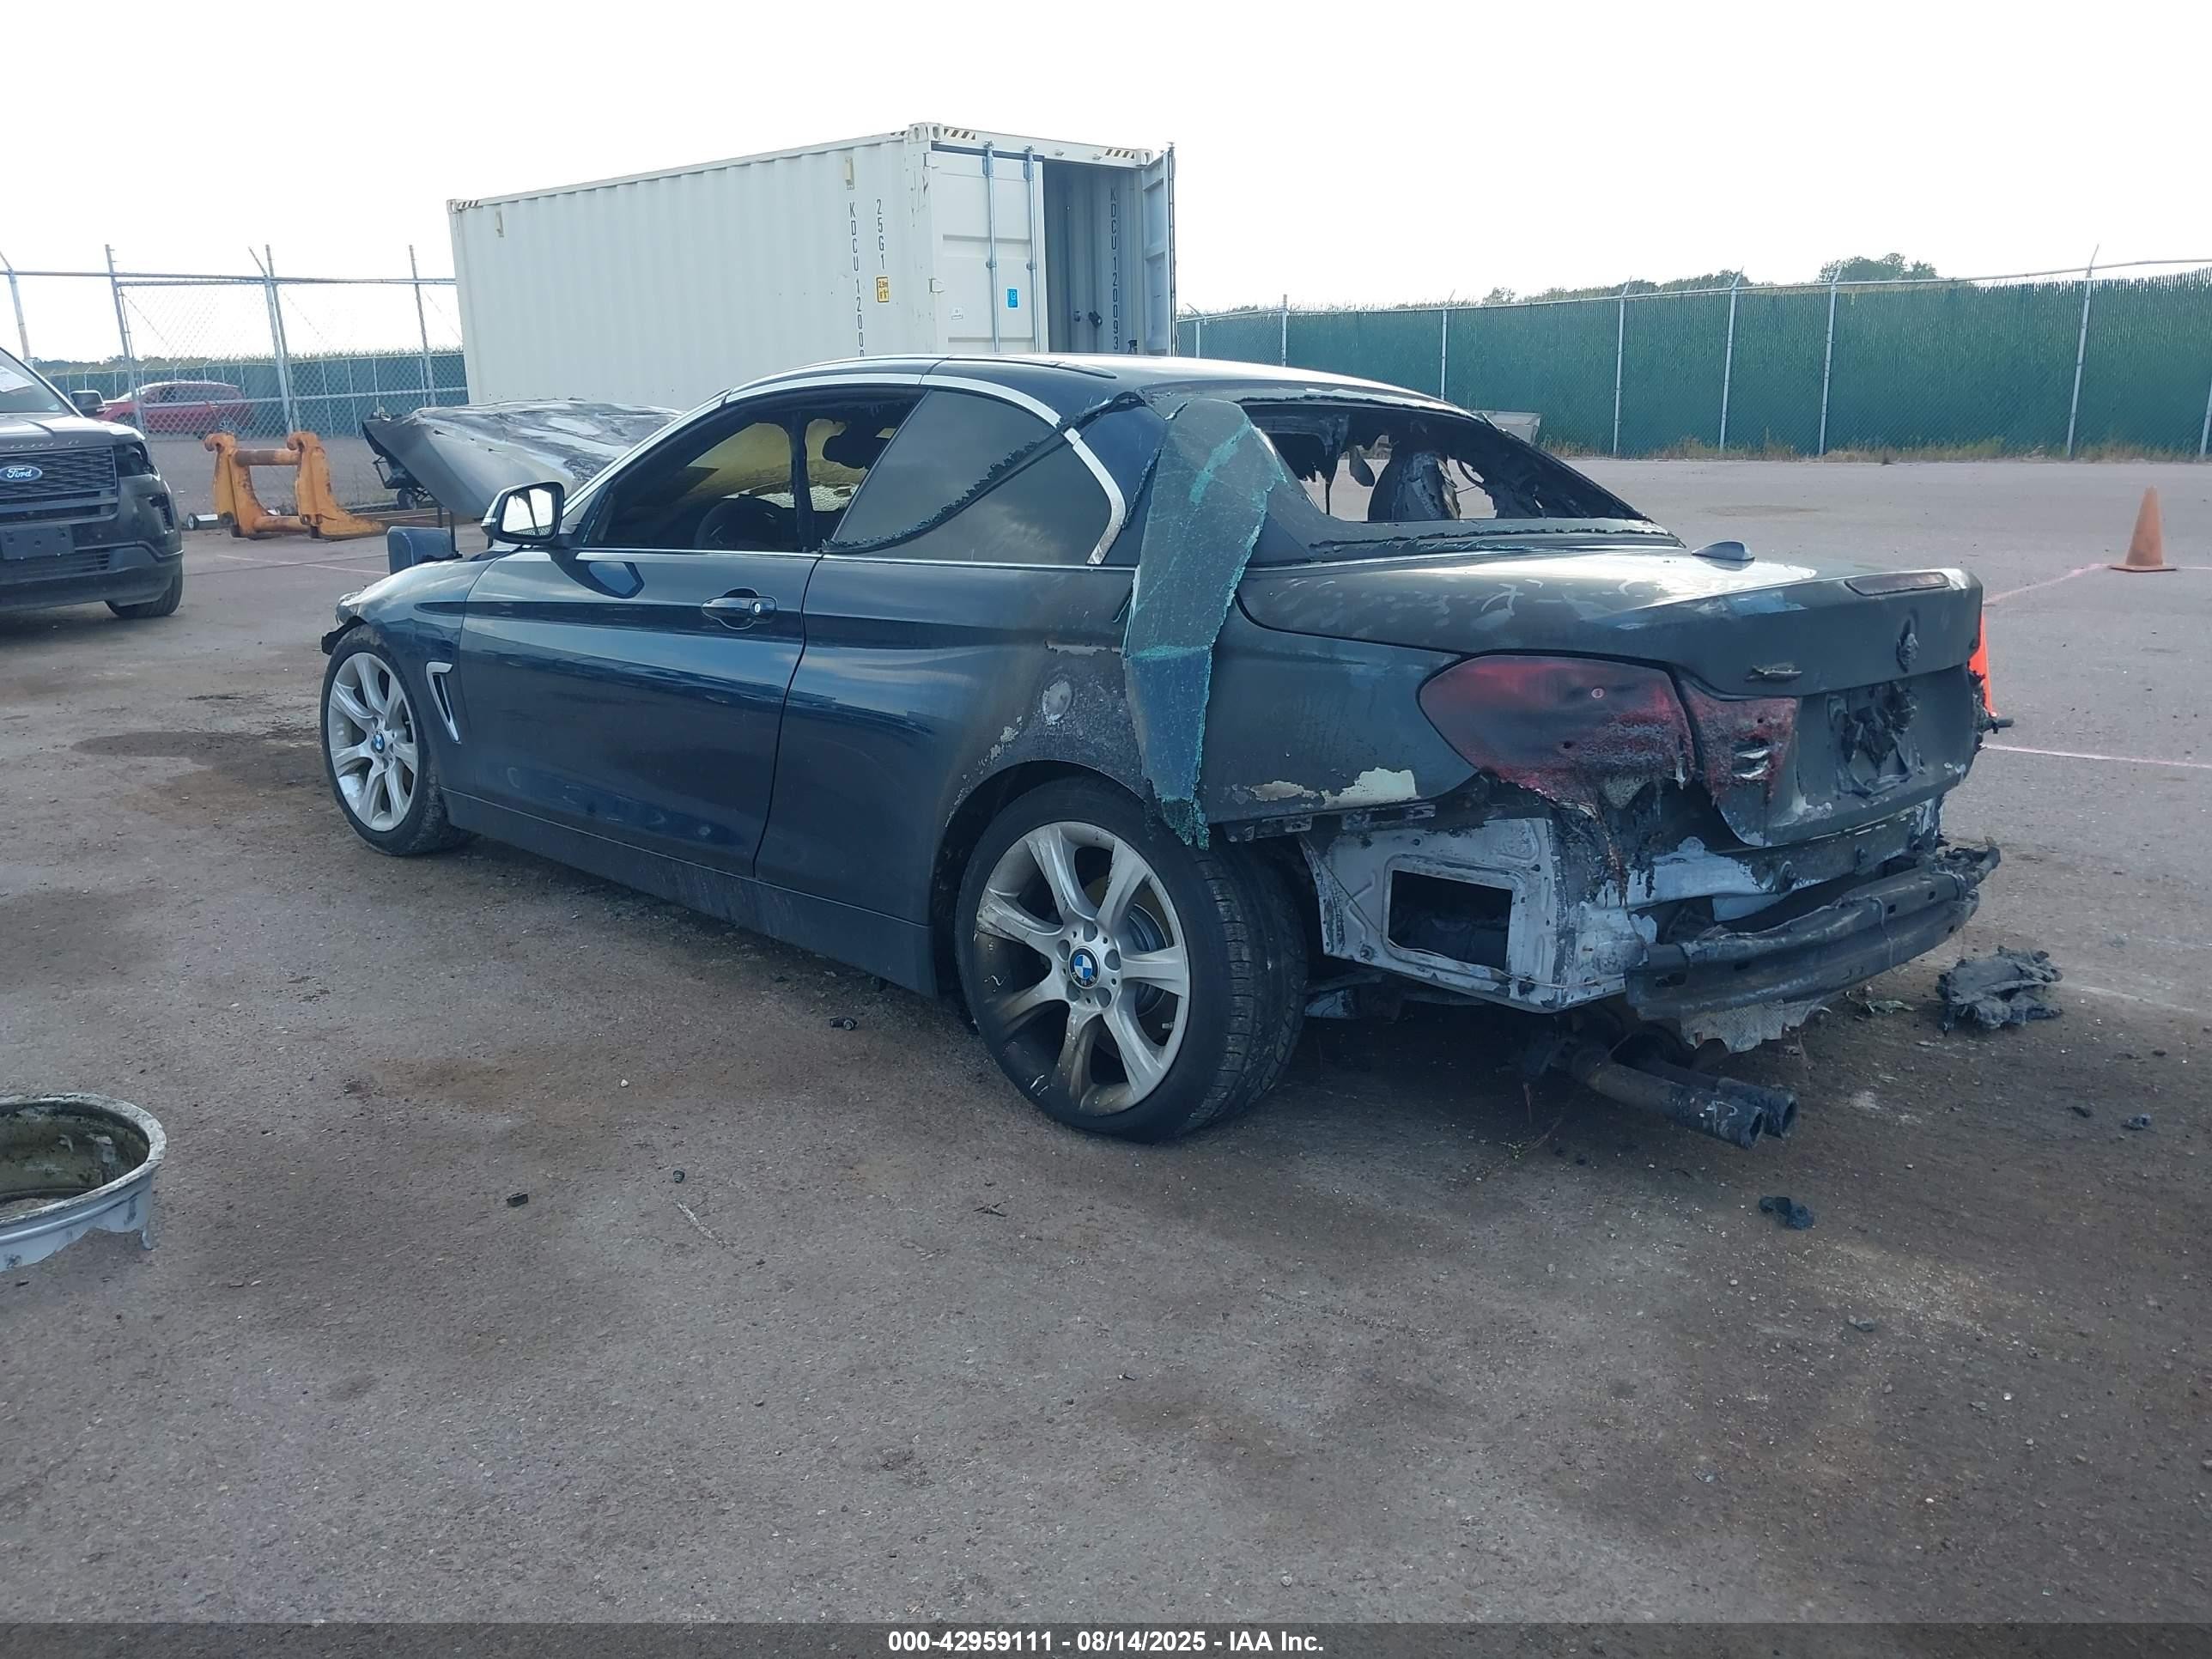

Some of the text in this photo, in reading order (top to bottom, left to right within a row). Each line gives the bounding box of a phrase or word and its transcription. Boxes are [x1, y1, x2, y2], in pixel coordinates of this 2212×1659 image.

[849, 201, 859, 271] KDCU
[876, 198, 885, 270] 25G1
[6, 467, 33, 479] Ford
